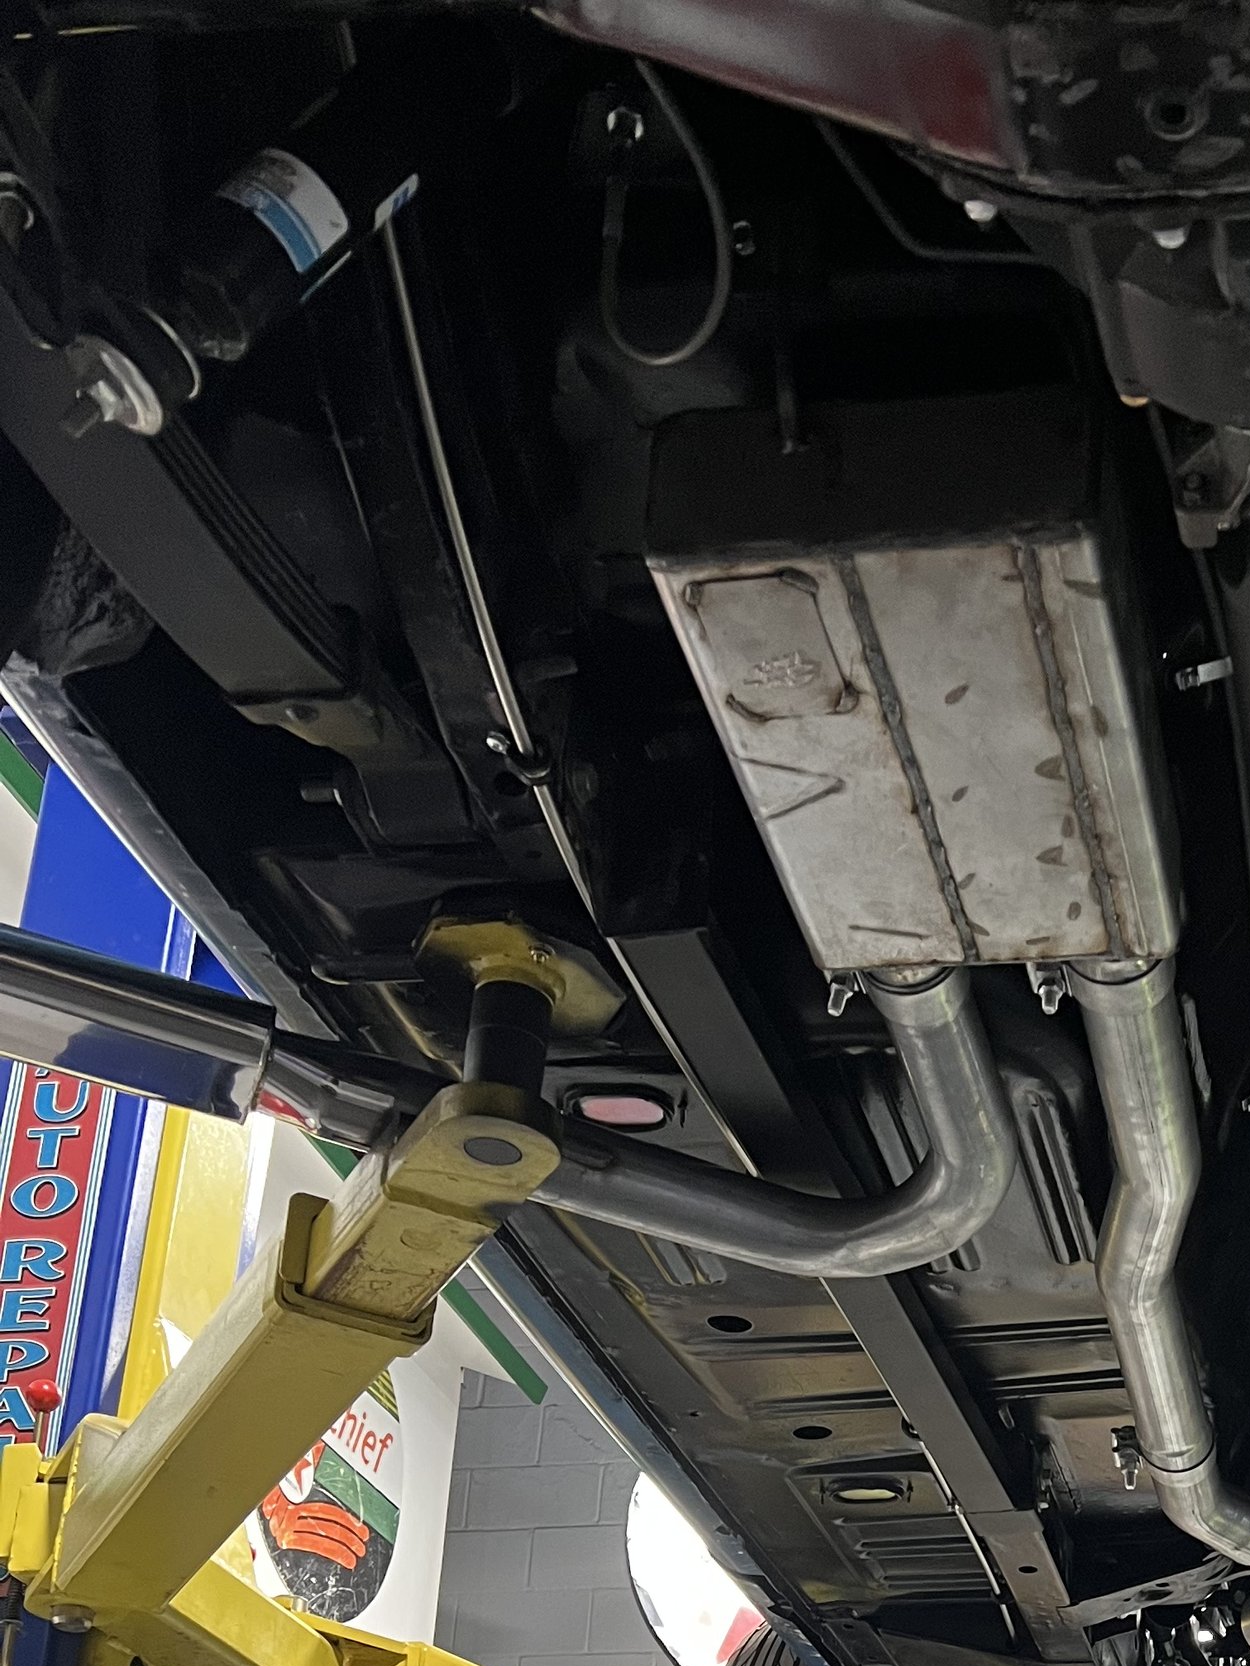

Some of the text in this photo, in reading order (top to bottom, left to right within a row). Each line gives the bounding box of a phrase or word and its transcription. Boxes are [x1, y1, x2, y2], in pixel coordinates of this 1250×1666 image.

[10, 1068, 90, 1218] UTO
[0, 1240, 67, 1446] REPA
[331, 1409, 394, 1473] hief
